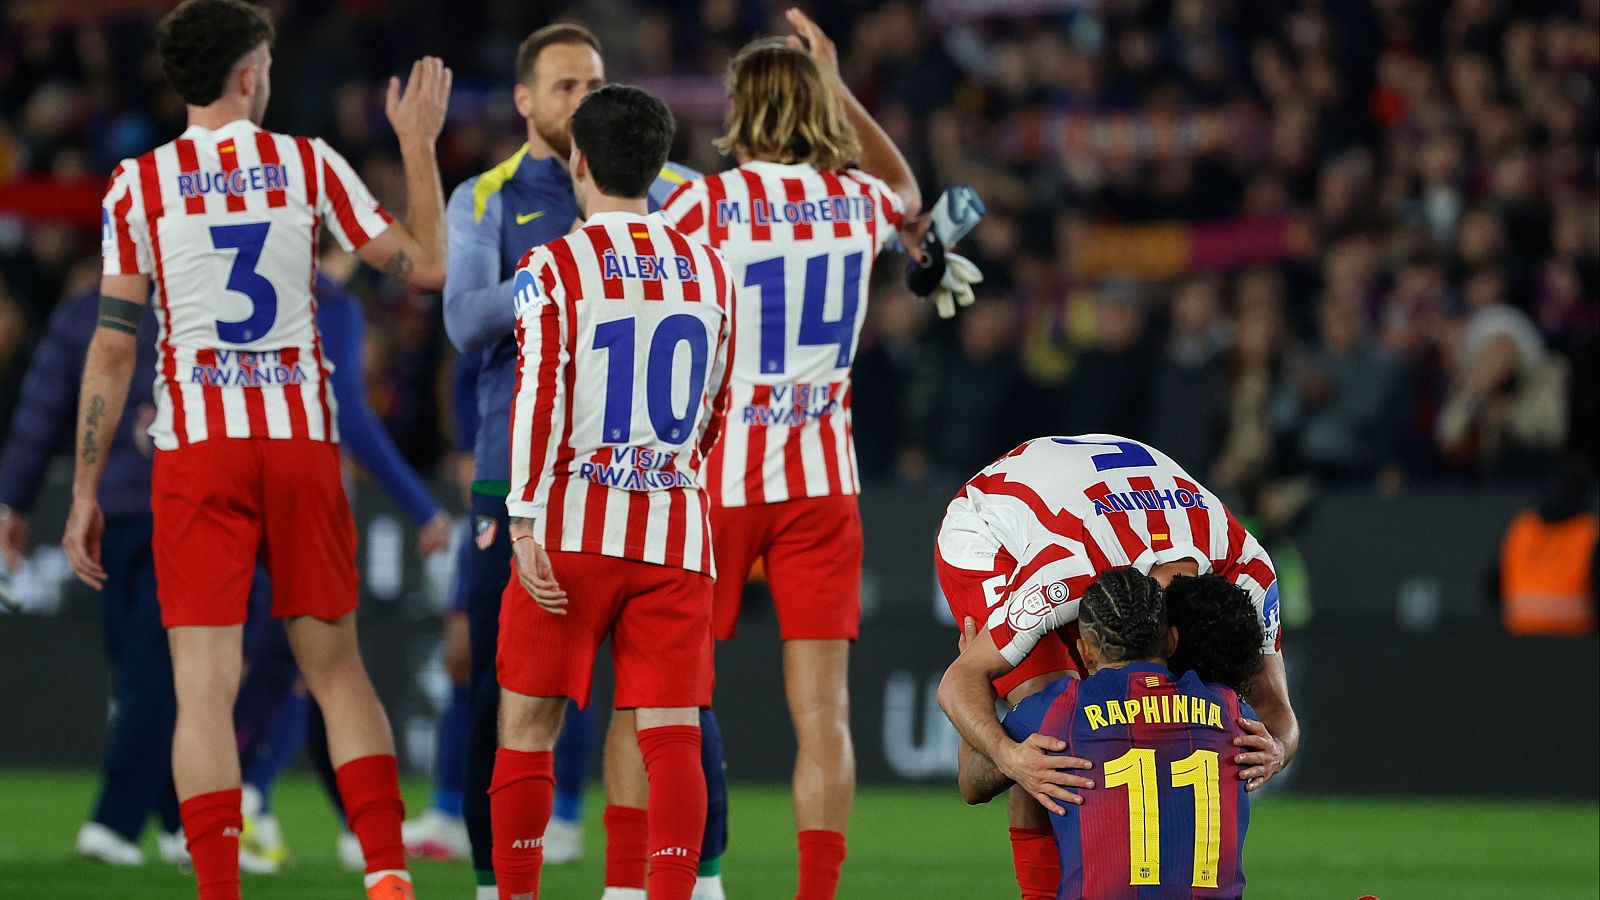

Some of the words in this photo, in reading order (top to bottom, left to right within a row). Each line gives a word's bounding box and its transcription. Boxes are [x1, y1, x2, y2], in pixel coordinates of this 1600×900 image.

[177, 164, 289, 197] RUGGERI
[603, 248, 669, 280] ÁLEX
[674, 256, 699, 282] B.
[209, 222, 278, 344] 3
[743, 251, 864, 374] 14
[191, 364, 307, 387] RWANDA
[592, 313, 708, 445] 10
[771, 384, 831, 406] VISIT
[614, 446, 673, 470] VISIT
[579, 462, 692, 490] RWANDA
[1091, 488, 1210, 517] JOHNNY
[1084, 694, 1224, 731] RAPHINHA
[1103, 748, 1221, 888] 11
